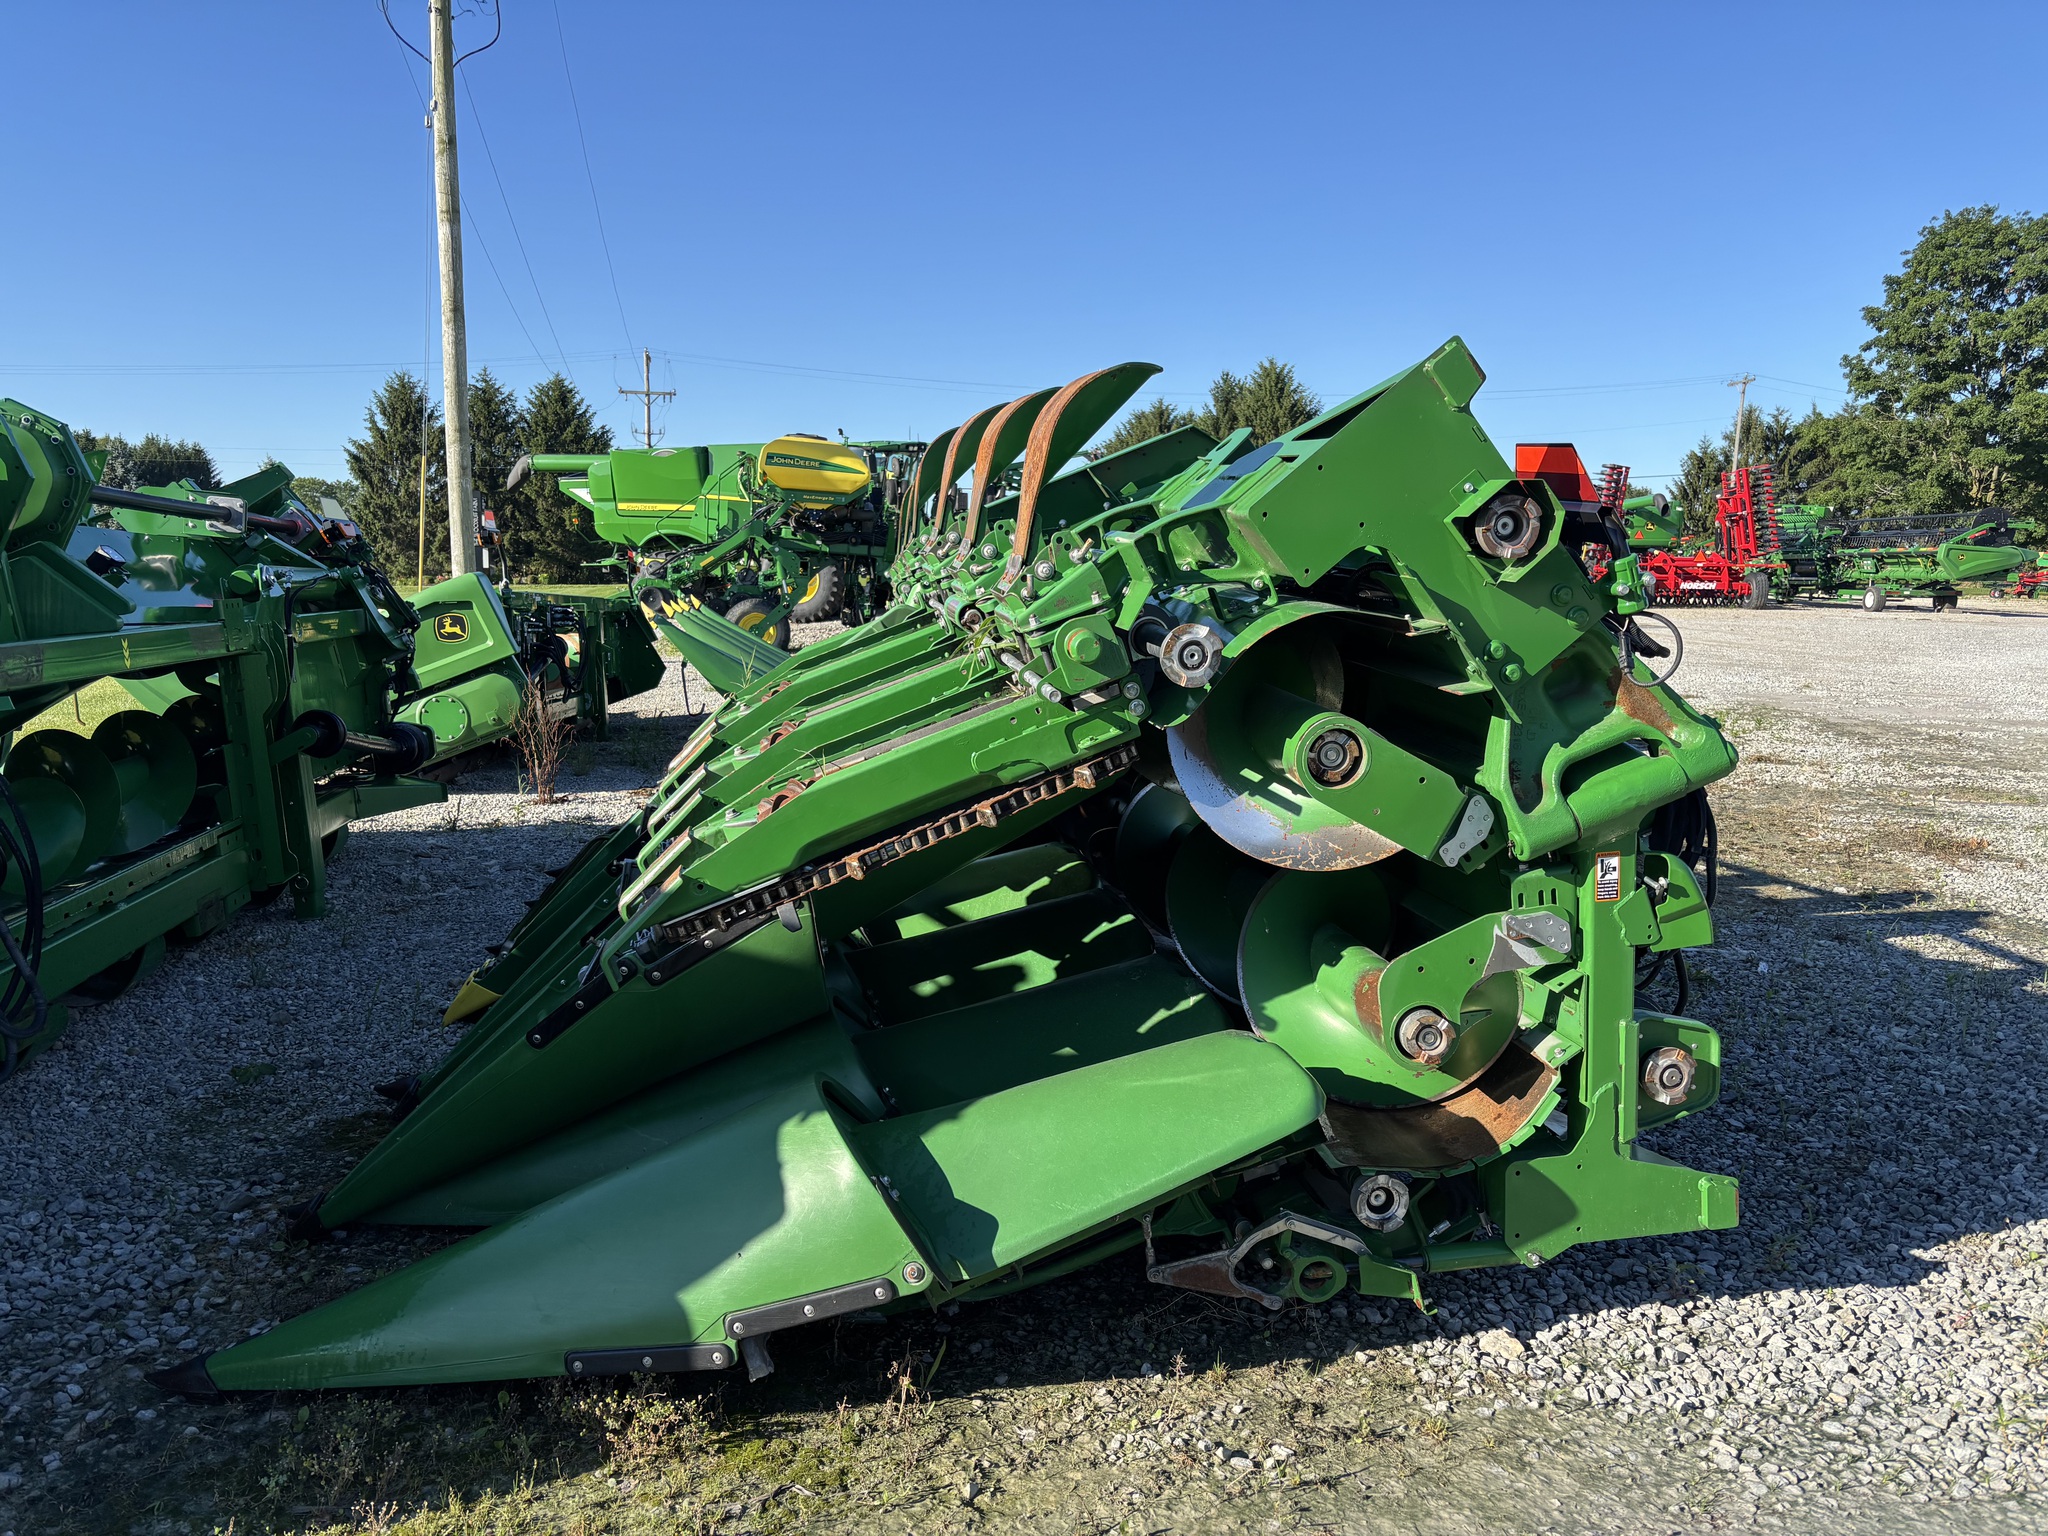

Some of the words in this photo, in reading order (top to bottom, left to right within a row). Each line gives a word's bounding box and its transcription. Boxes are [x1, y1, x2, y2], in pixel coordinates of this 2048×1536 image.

[771, 456, 793, 465] JOHN
[794, 458, 820, 467] DEERE
[1680, 581, 1717, 590] HORSCH
